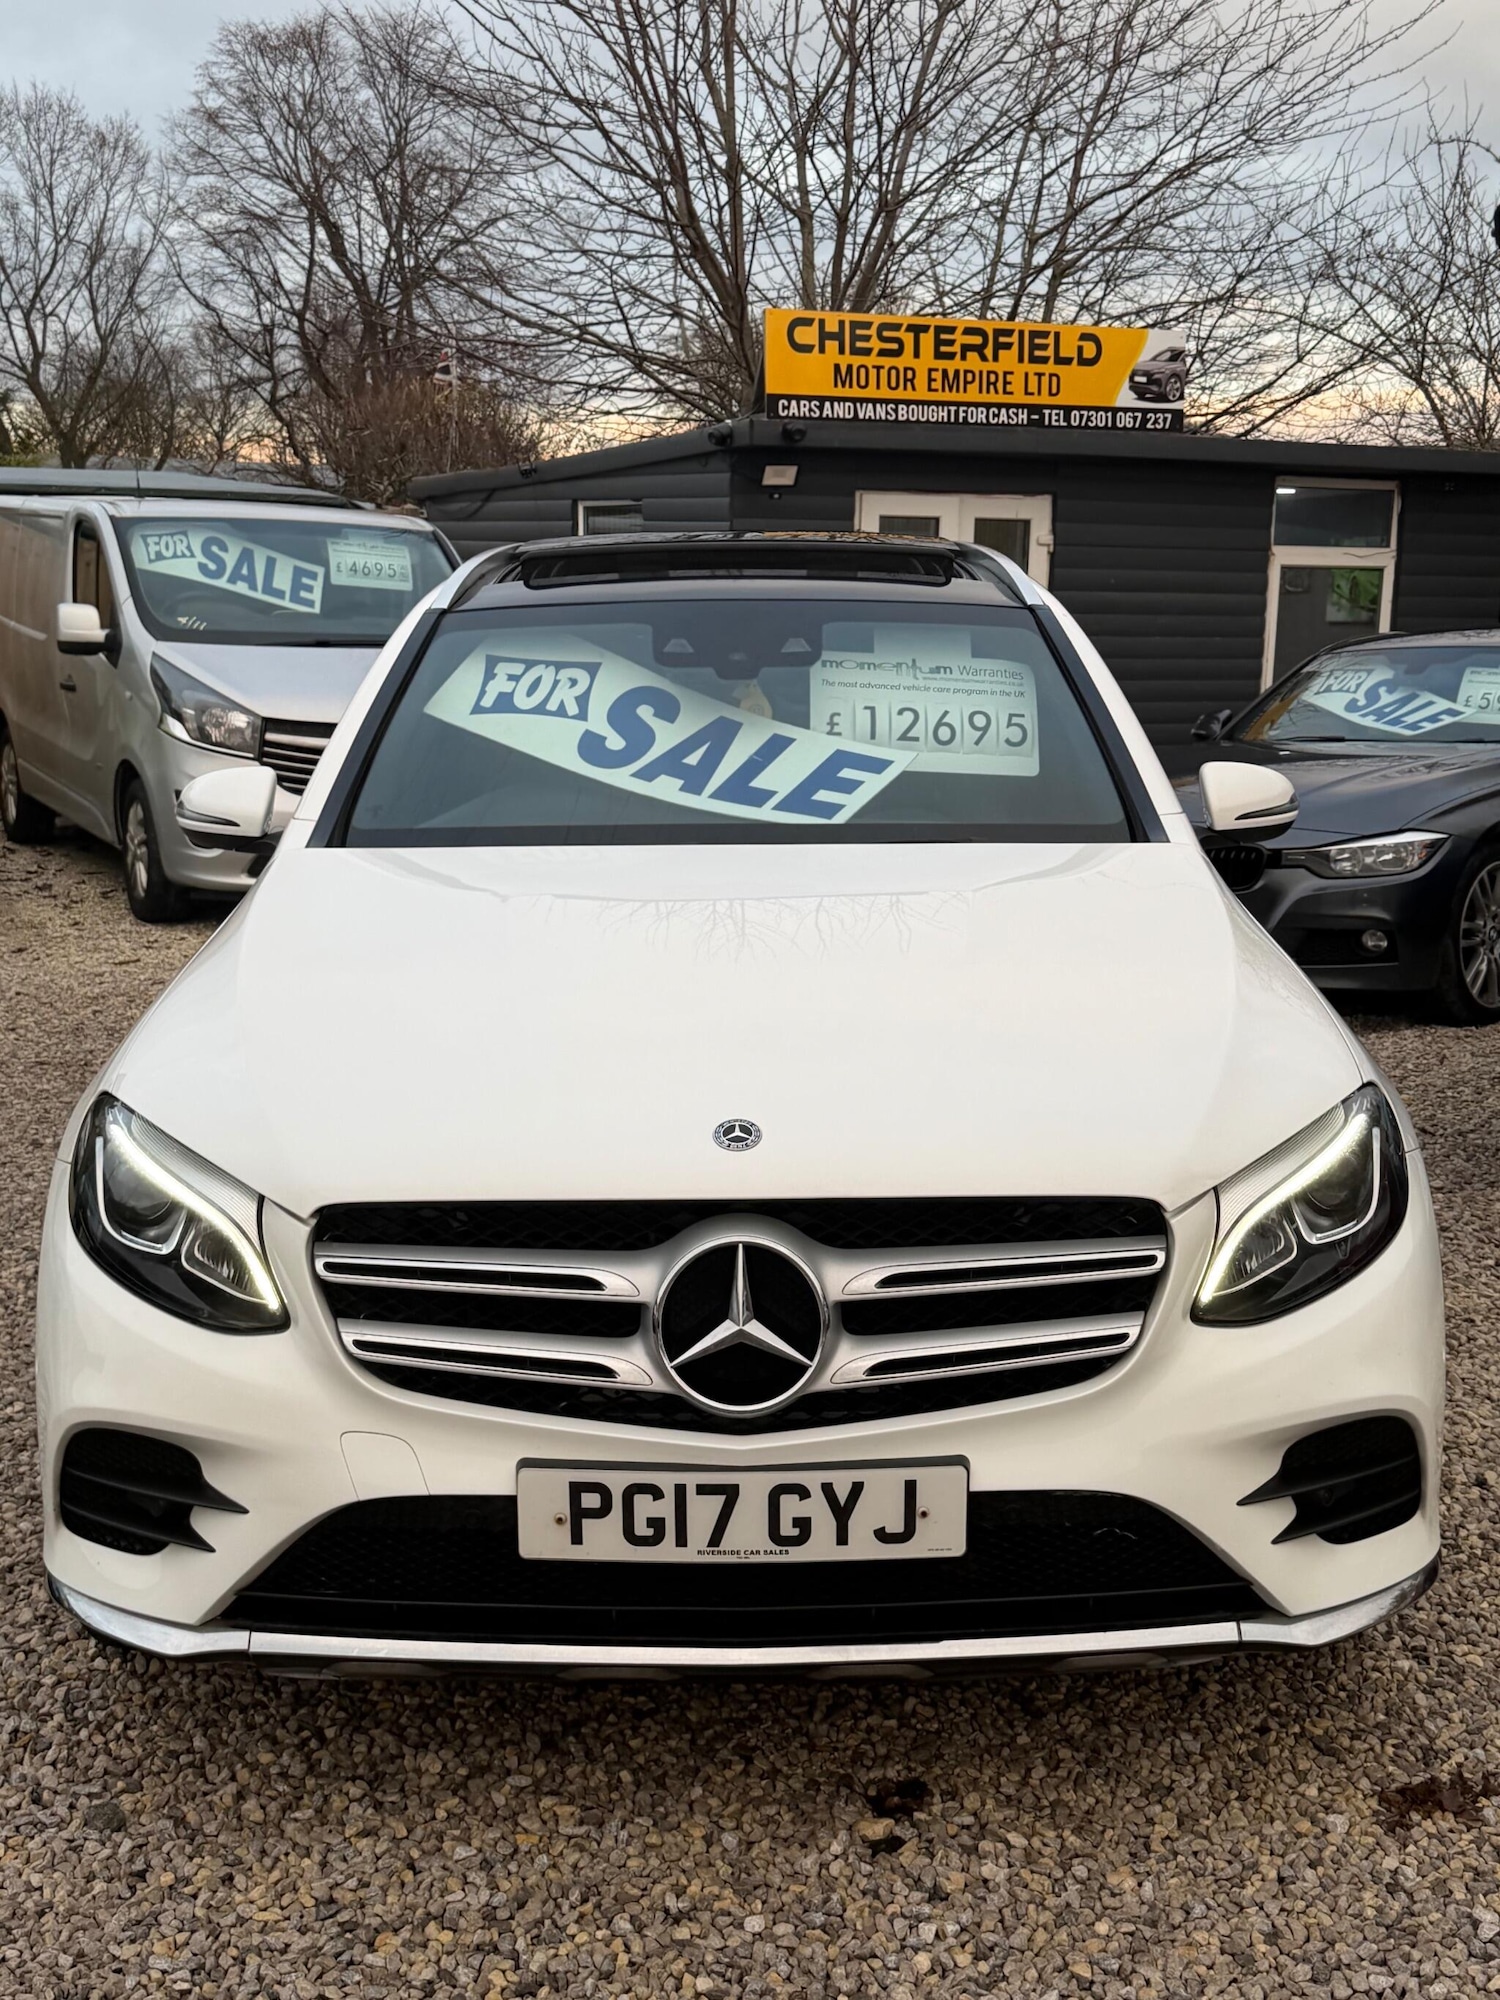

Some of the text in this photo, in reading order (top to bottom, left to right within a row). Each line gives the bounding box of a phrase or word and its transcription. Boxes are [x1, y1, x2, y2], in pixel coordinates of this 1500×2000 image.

[787, 316, 1103, 367] CHESTERFIELD
[833, 363, 1061, 397] MOTOR EMPIRE LTD
[778, 399, 820, 418] CARS
[822, 401, 854, 419] AND
[856, 402, 896, 421] VANS
[898, 403, 958, 423] BOUGHT
[959, 405, 988, 424] FOR
[989, 406, 1028, 425] CASH
[1042, 409, 1067, 426] TEL
[1071, 410, 1112, 428] 07301
[1116, 411, 1142, 429] 067
[1146, 413, 1172, 430] 237
[145, 533, 319, 610] FOR SALE
[821, 658, 1025, 681] momentum Warranties
[821, 679, 1027, 698] The most advanced vehicle care program in the UK
[1319, 669, 1467, 732] FOR SALE
[479, 661, 895, 821] FOR SALE
[568, 1479, 918, 1548] PG17 GYJ
[763, 1548, 790, 1556] SALES
